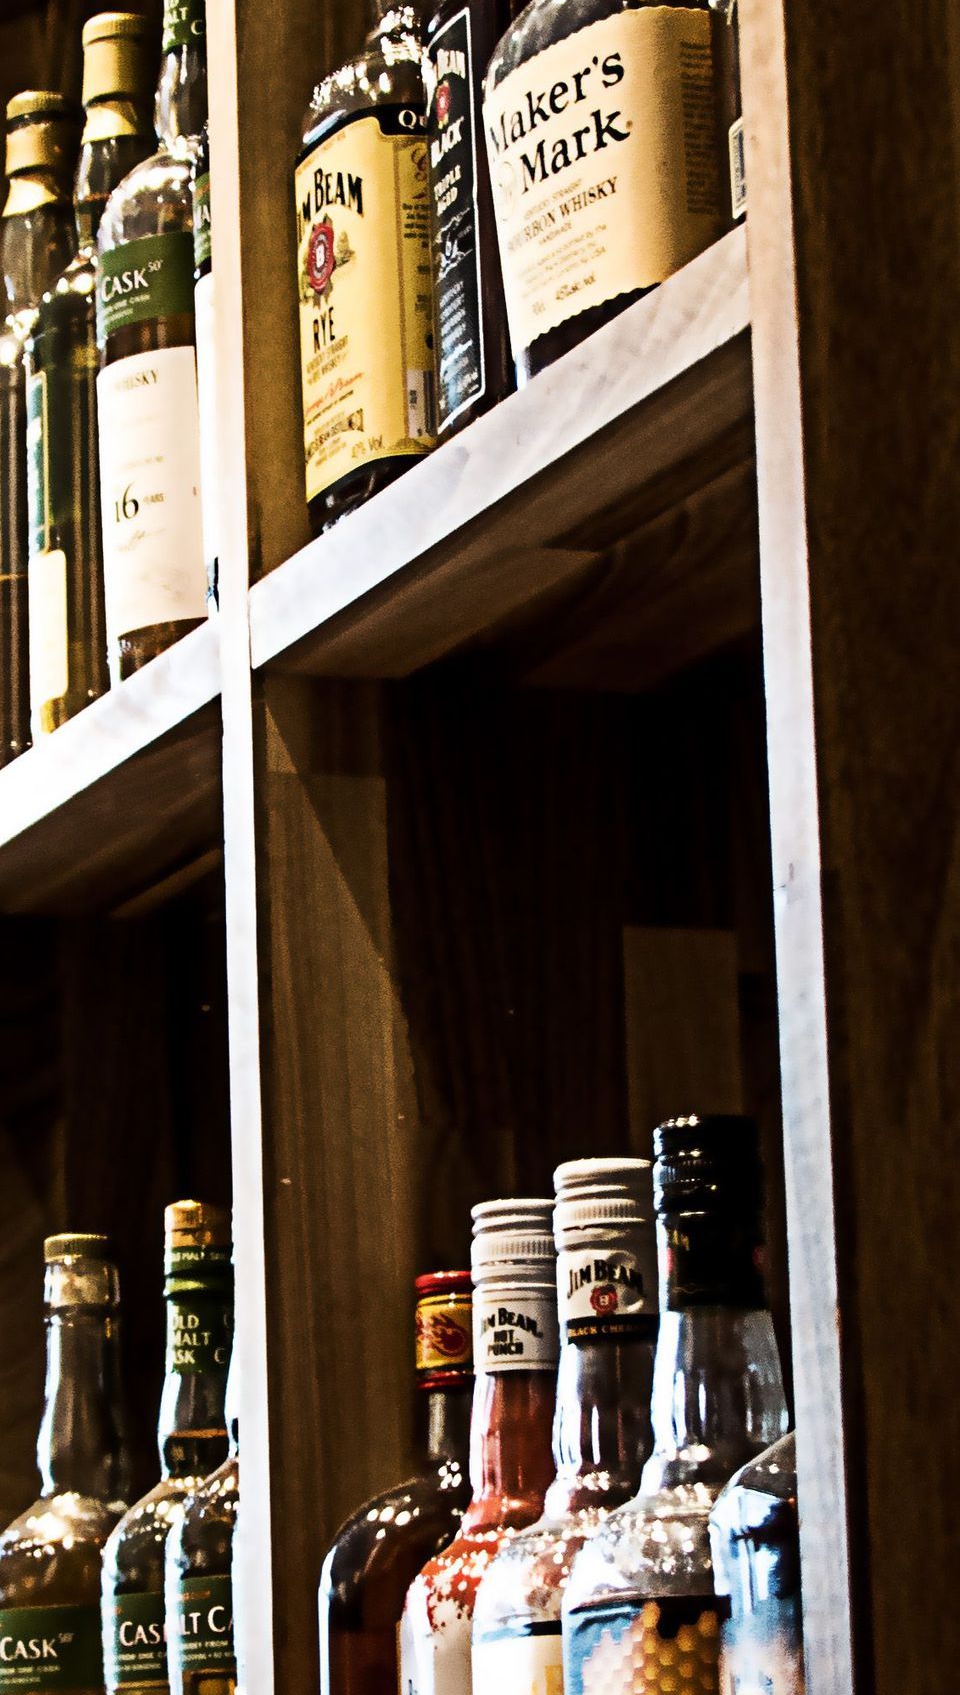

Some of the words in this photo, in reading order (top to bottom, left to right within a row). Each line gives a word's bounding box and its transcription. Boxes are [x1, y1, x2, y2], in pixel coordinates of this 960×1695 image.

[489, 52, 626, 155] Maker's
[430, 118, 463, 169] BLACK
[520, 108, 631, 195] Mark
[313, 167, 365, 219] BEAM
[558, 176, 618, 218] WHISKY
[102, 267, 150, 303] CASK
[312, 306, 337, 354] RYE
[115, 481, 139, 523] 16
[567, 1264, 591, 1299] JIM
[593, 1258, 644, 1296] BEAM
[494, 1329, 515, 1344] HOT
[497, 1307, 543, 1338] BEAM
[568, 1326, 598, 1338] BLACK
[488, 1342, 524, 1356] PUNCH
[0, 1636, 58, 1663] CASK
[119, 1620, 163, 1647] CAS
